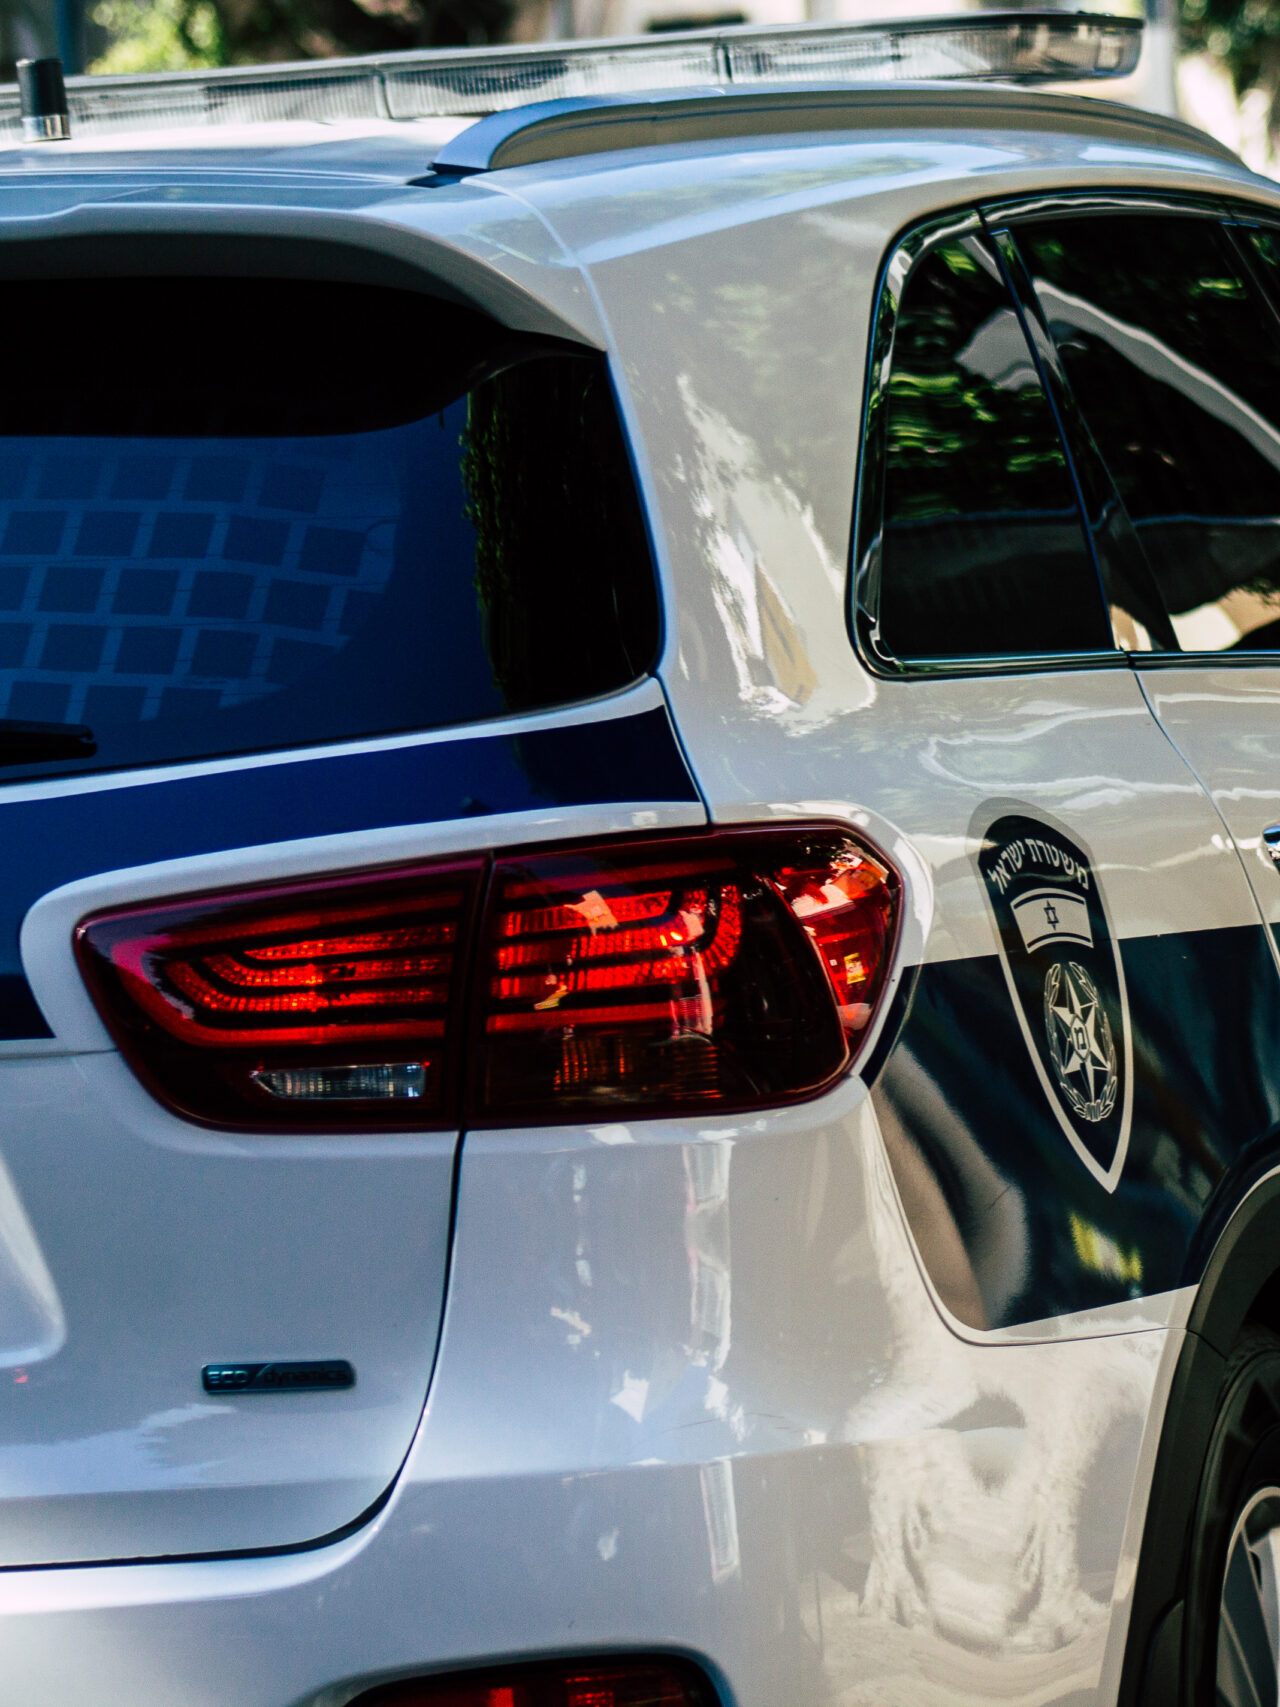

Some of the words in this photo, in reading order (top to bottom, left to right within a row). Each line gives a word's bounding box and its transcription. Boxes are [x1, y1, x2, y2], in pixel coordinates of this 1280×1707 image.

[987, 840, 1026, 895] ישראל
[1024, 838, 1089, 890] משטרת
[207, 1370, 249, 1384] ECO
